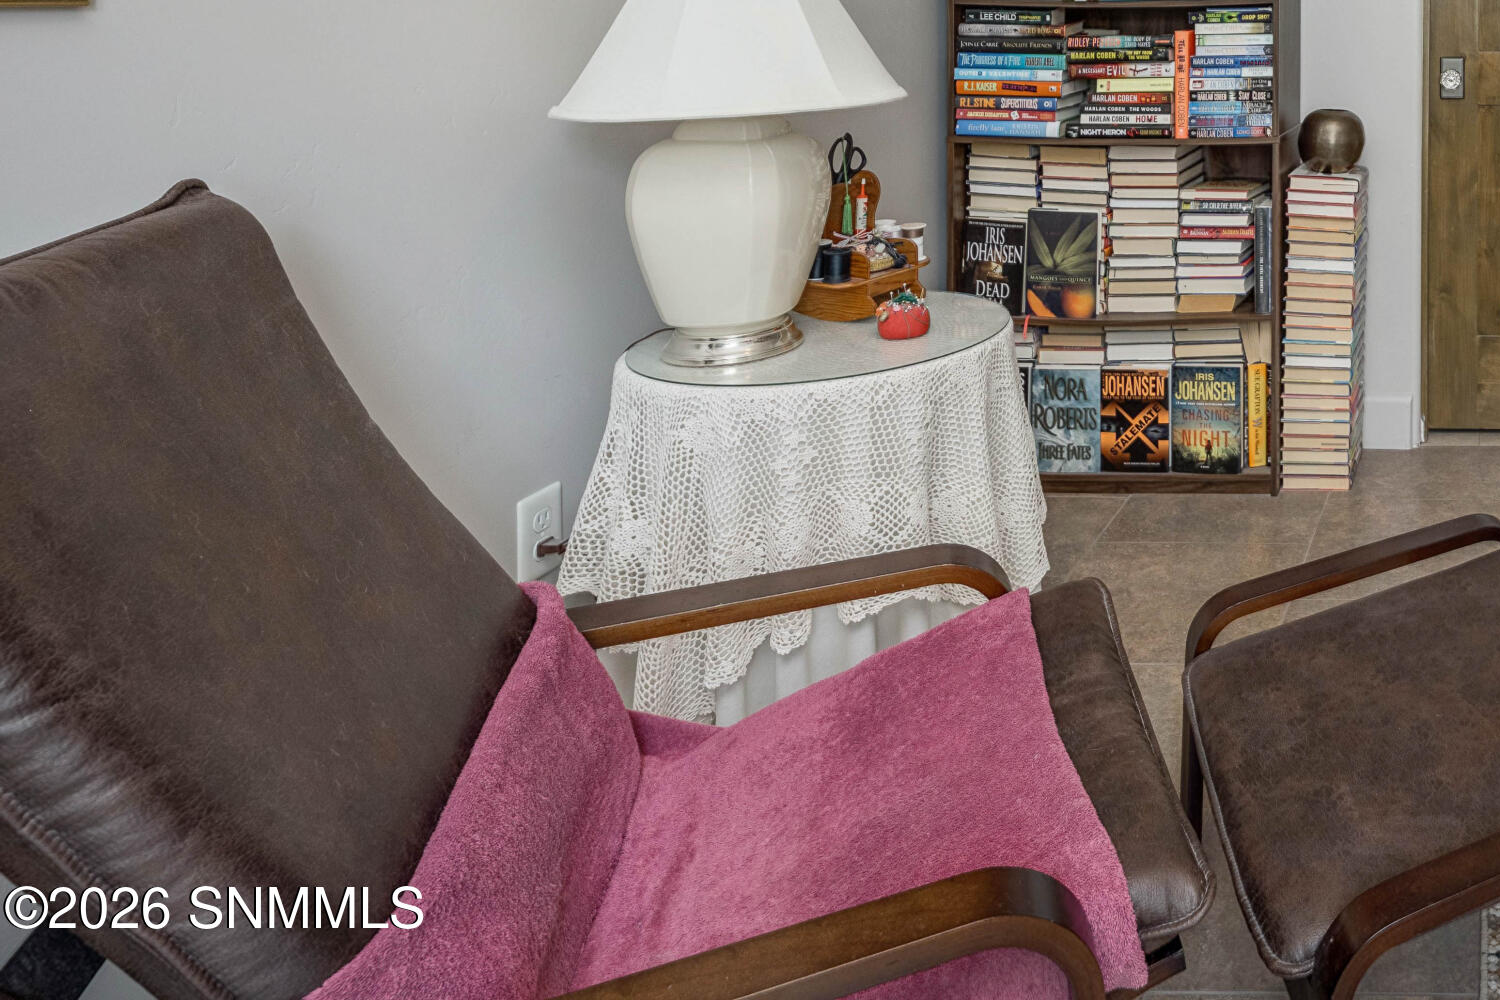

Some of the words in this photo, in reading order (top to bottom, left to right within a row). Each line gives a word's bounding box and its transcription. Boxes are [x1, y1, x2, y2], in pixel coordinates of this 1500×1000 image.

[1193, 57, 1215, 65] HARLAN
[1216, 57, 1234, 65] COBEN
[986, 227, 1005, 244] IRIS
[966, 241, 1023, 264] JOHANSEN
[975, 279, 1010, 298] DEAD
[1102, 375, 1165, 397] JOHANSEN
[1195, 372, 1215, 382] IRIS
[1044, 374, 1088, 402] NORA
[1175, 380, 1236, 401] JOHANSEN
[1032, 402, 1097, 436] ROBERTS
[1181, 408, 1231, 422] CHASING
[1110, 403, 1162, 456] STALEMATE
[1181, 430, 1231, 448] NIGHT
[1037, 442, 1065, 461] THREE
[1067, 444, 1092, 461] FATES
